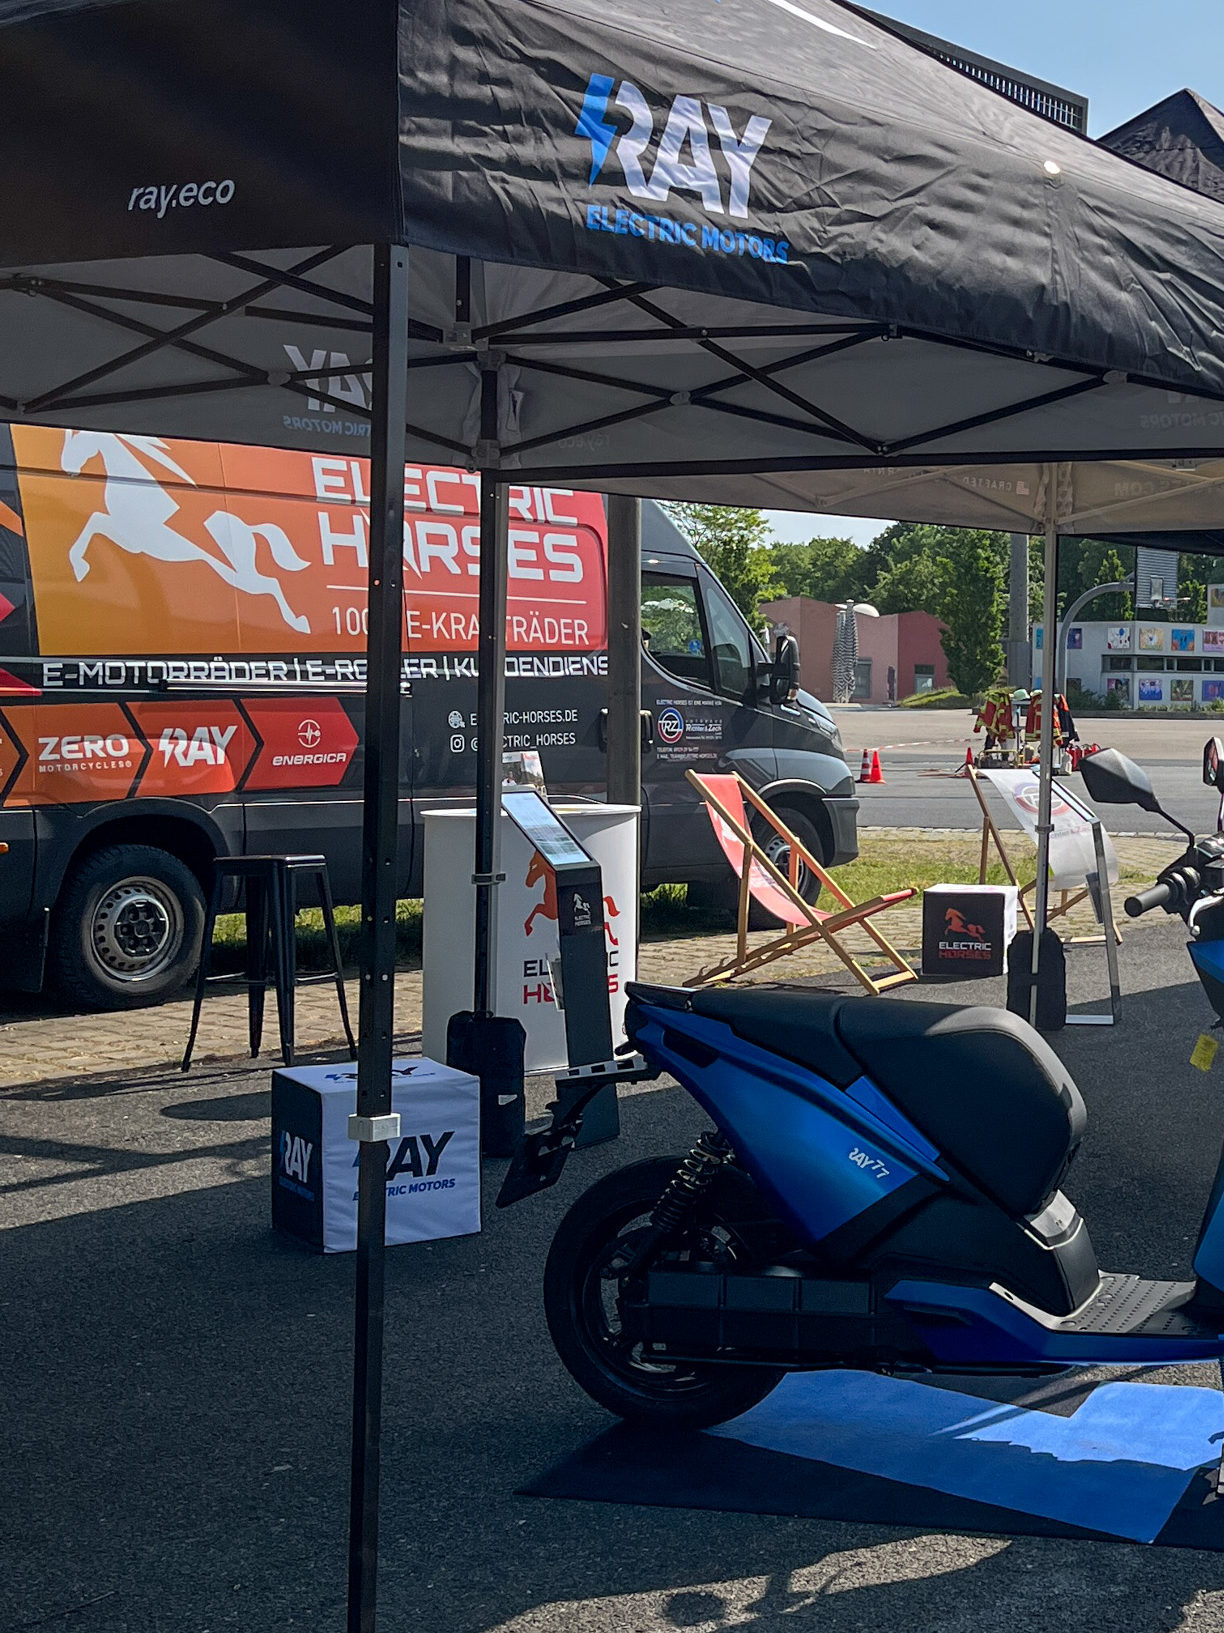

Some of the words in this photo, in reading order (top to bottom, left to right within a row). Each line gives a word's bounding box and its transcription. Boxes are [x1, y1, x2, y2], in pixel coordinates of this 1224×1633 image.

[575, 73, 773, 219] RAY
[128, 180, 235, 218] ray.eco
[587, 205, 697, 246] ELECTRIC
[701, 225, 790, 264] MOTORS
[406, 611, 590, 646] E-KRATRÄDER
[38, 733, 130, 761] ZERO
[159, 725, 238, 768] RAY
[938, 941, 992, 951] ELECTRIC
[938, 951, 992, 960] HORSES
[280, 1130, 314, 1184] RAY
[408, 1178, 456, 1194] MOTORS
